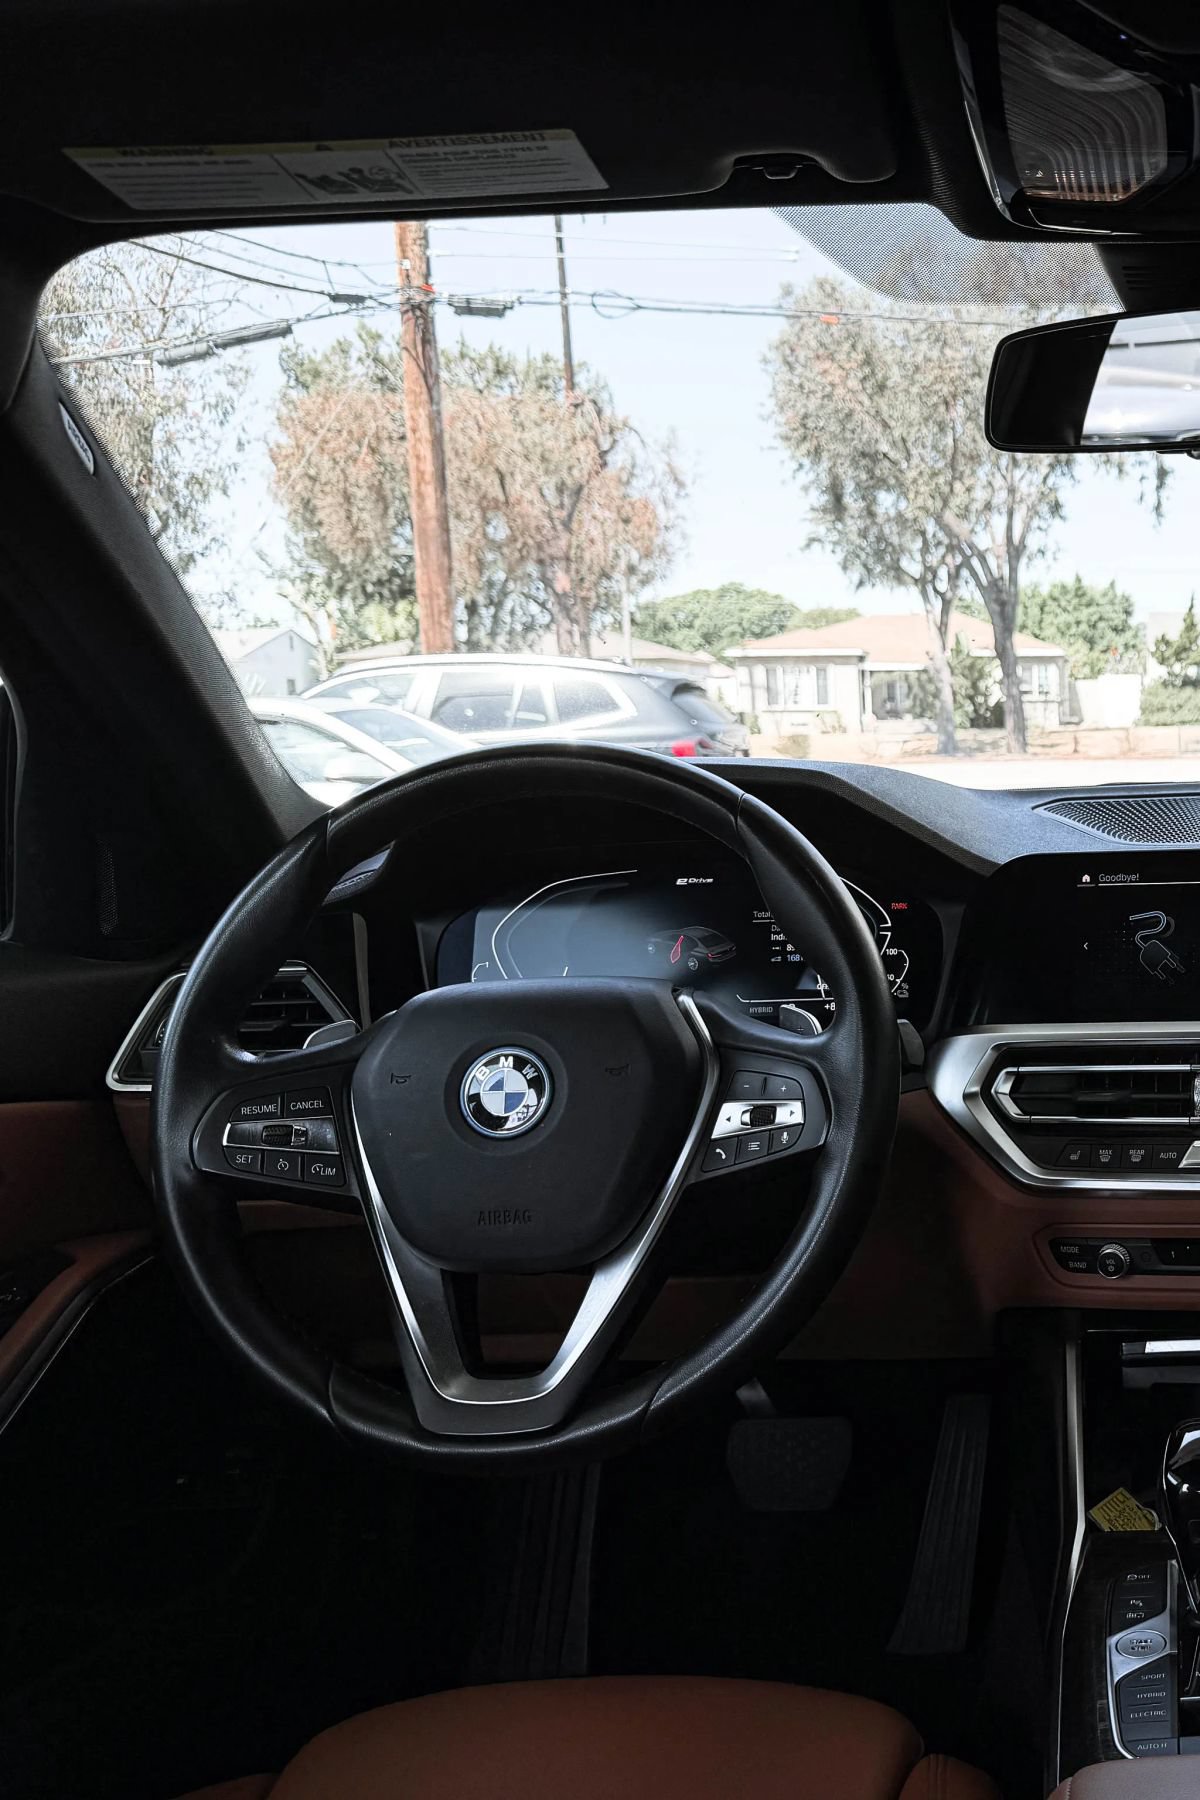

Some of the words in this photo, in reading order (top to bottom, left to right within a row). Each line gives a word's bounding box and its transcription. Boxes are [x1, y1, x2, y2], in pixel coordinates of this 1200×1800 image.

[387, 132, 546, 149] AVERTISSEMENT
[1098, 873, 1140, 882] Goodbye!
[752, 911, 771, 919] Total
[885, 948, 898, 956] 100
[749, 1006, 774, 1015] HYBRID
[475, 1056, 538, 1081] BMW
[241, 1103, 278, 1116] RESUME
[290, 1100, 325, 1111] CANCEL
[235, 1154, 254, 1164] SET
[320, 1166, 336, 1176] LIM
[477, 1208, 534, 1226] AIRBAG
[1060, 1246, 1080, 1254] MODE
[1068, 1261, 1087, 1269] BAND
[1140, 1673, 1166, 1681] SPORT
[1129, 1710, 1167, 1719] ELECTRIC
